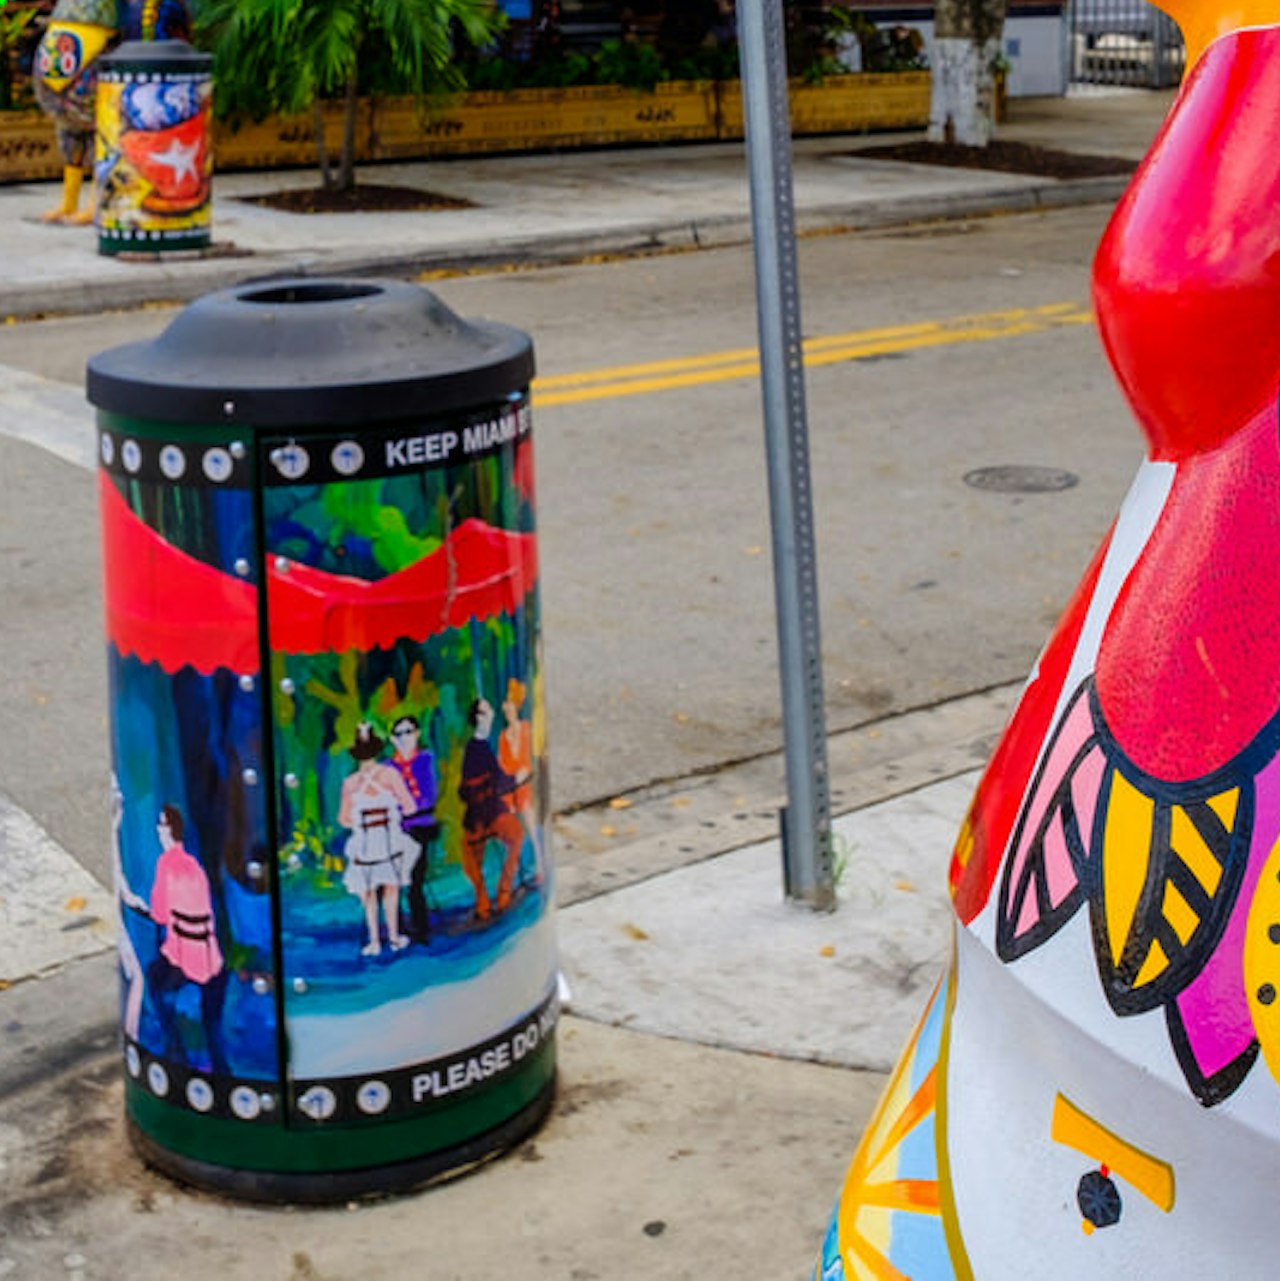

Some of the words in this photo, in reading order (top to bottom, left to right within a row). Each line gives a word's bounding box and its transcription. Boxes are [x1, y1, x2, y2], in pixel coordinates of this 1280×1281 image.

[384, 431, 459, 468] KEEP
[411, 1042, 511, 1103] PLEASE
[511, 1023, 539, 1060] DO
